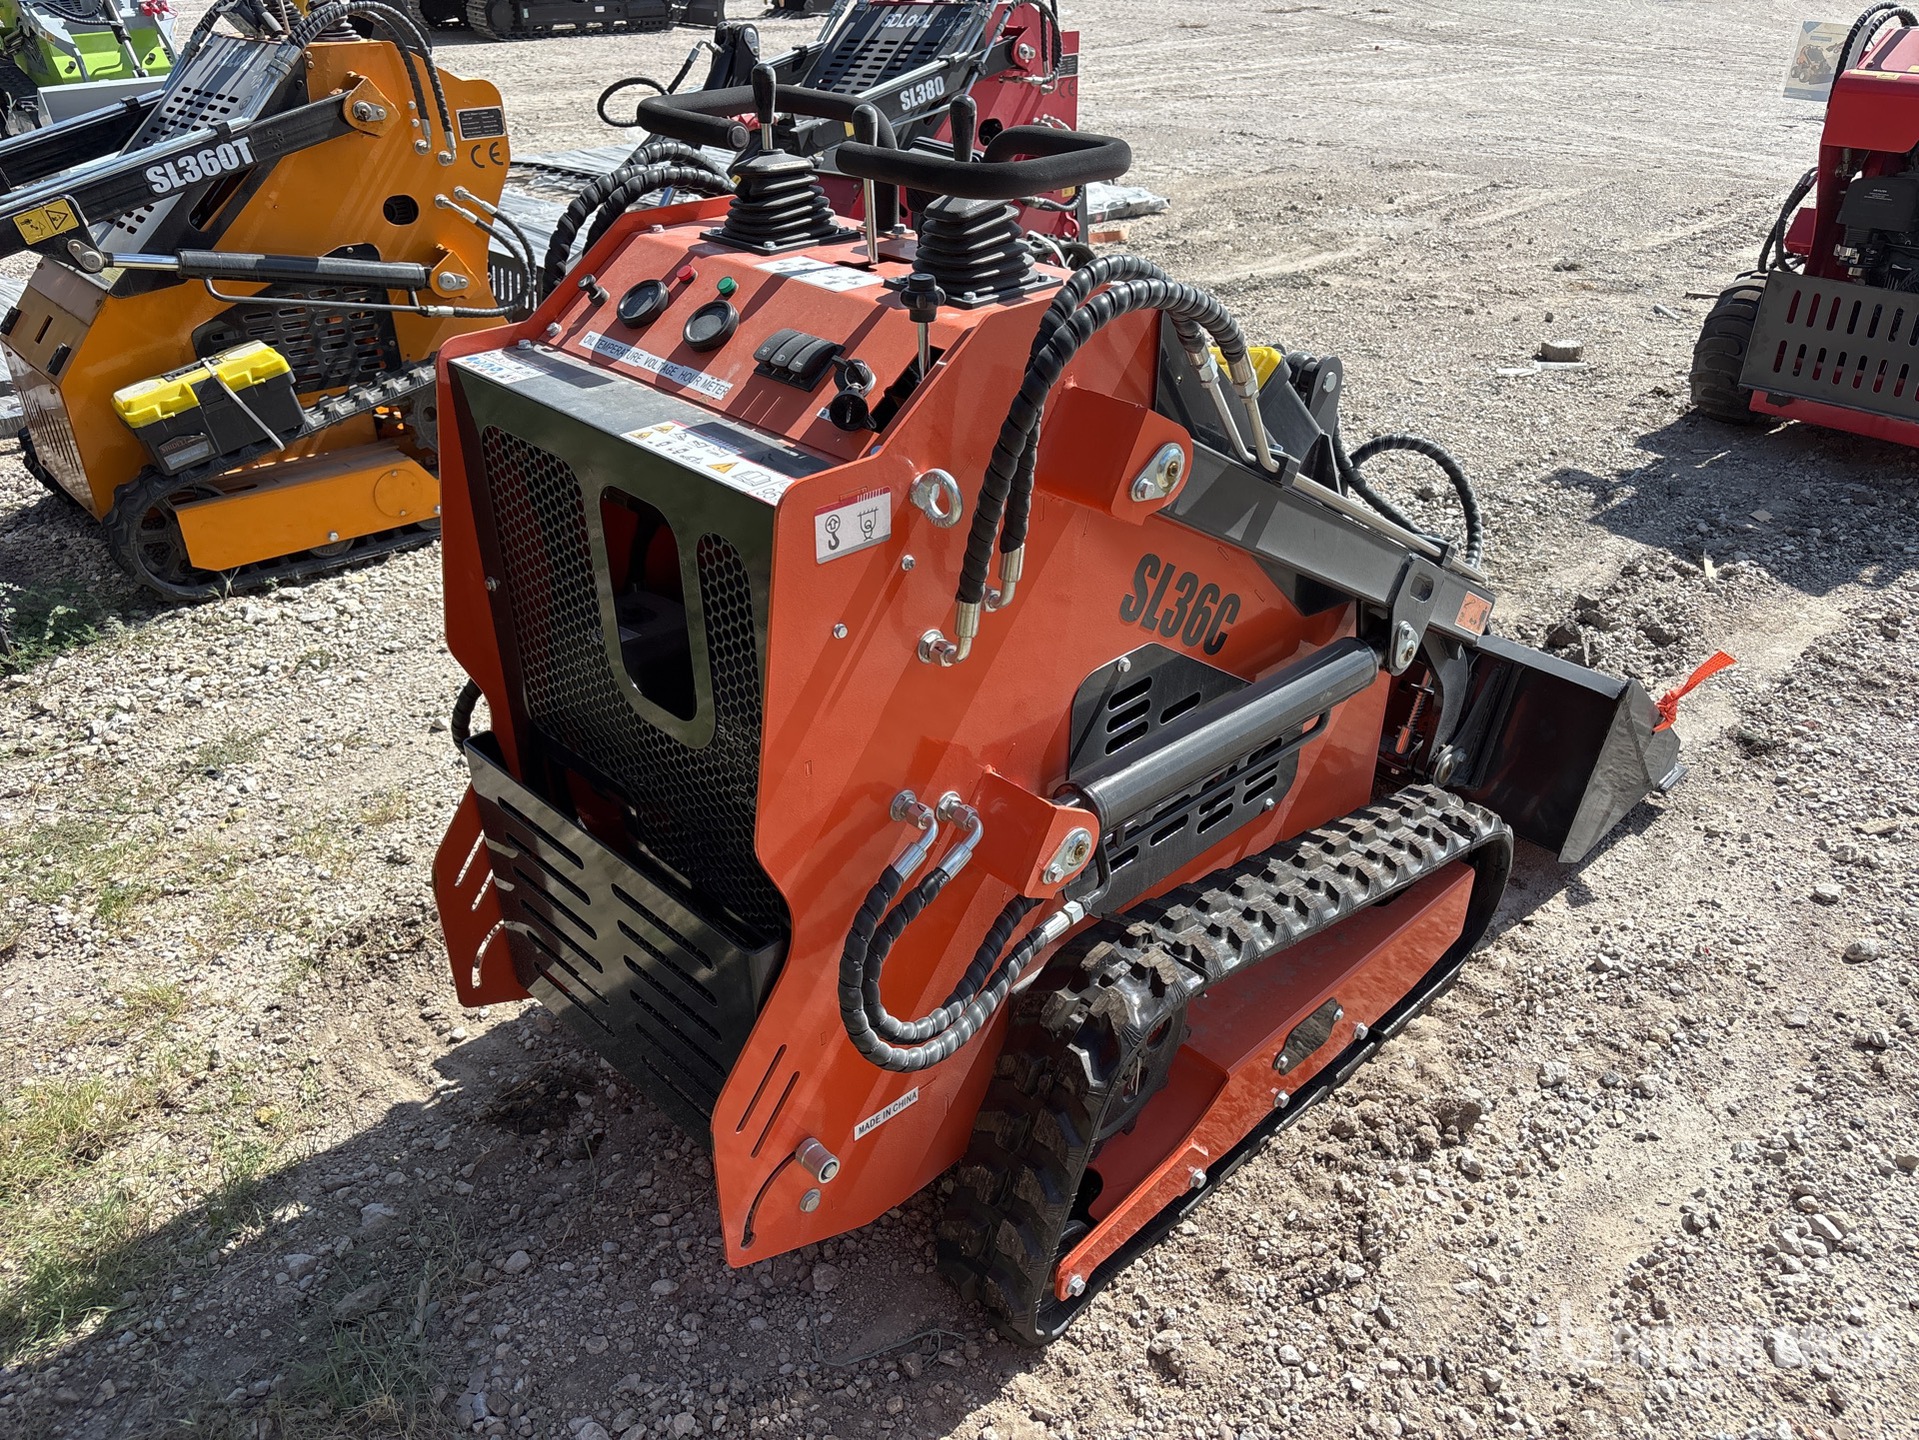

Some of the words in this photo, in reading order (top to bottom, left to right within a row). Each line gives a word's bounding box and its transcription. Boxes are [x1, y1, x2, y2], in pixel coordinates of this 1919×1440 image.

[900, 76, 945, 110] SL380
[146, 136, 254, 193] SL360T
[471, 141, 504, 168] CE
[583, 334, 594, 346] OIL
[594, 338, 644, 363] TEMPERATURE
[643, 356, 679, 377] VOLTAGE
[678, 370, 703, 387] HOUR
[700, 379, 730, 397] METER
[1120, 553, 1241, 655] SL36C
[858, 1114, 881, 1135] MADE
[882, 1107, 892, 1119] IN
[892, 1091, 917, 1112] CHINA
